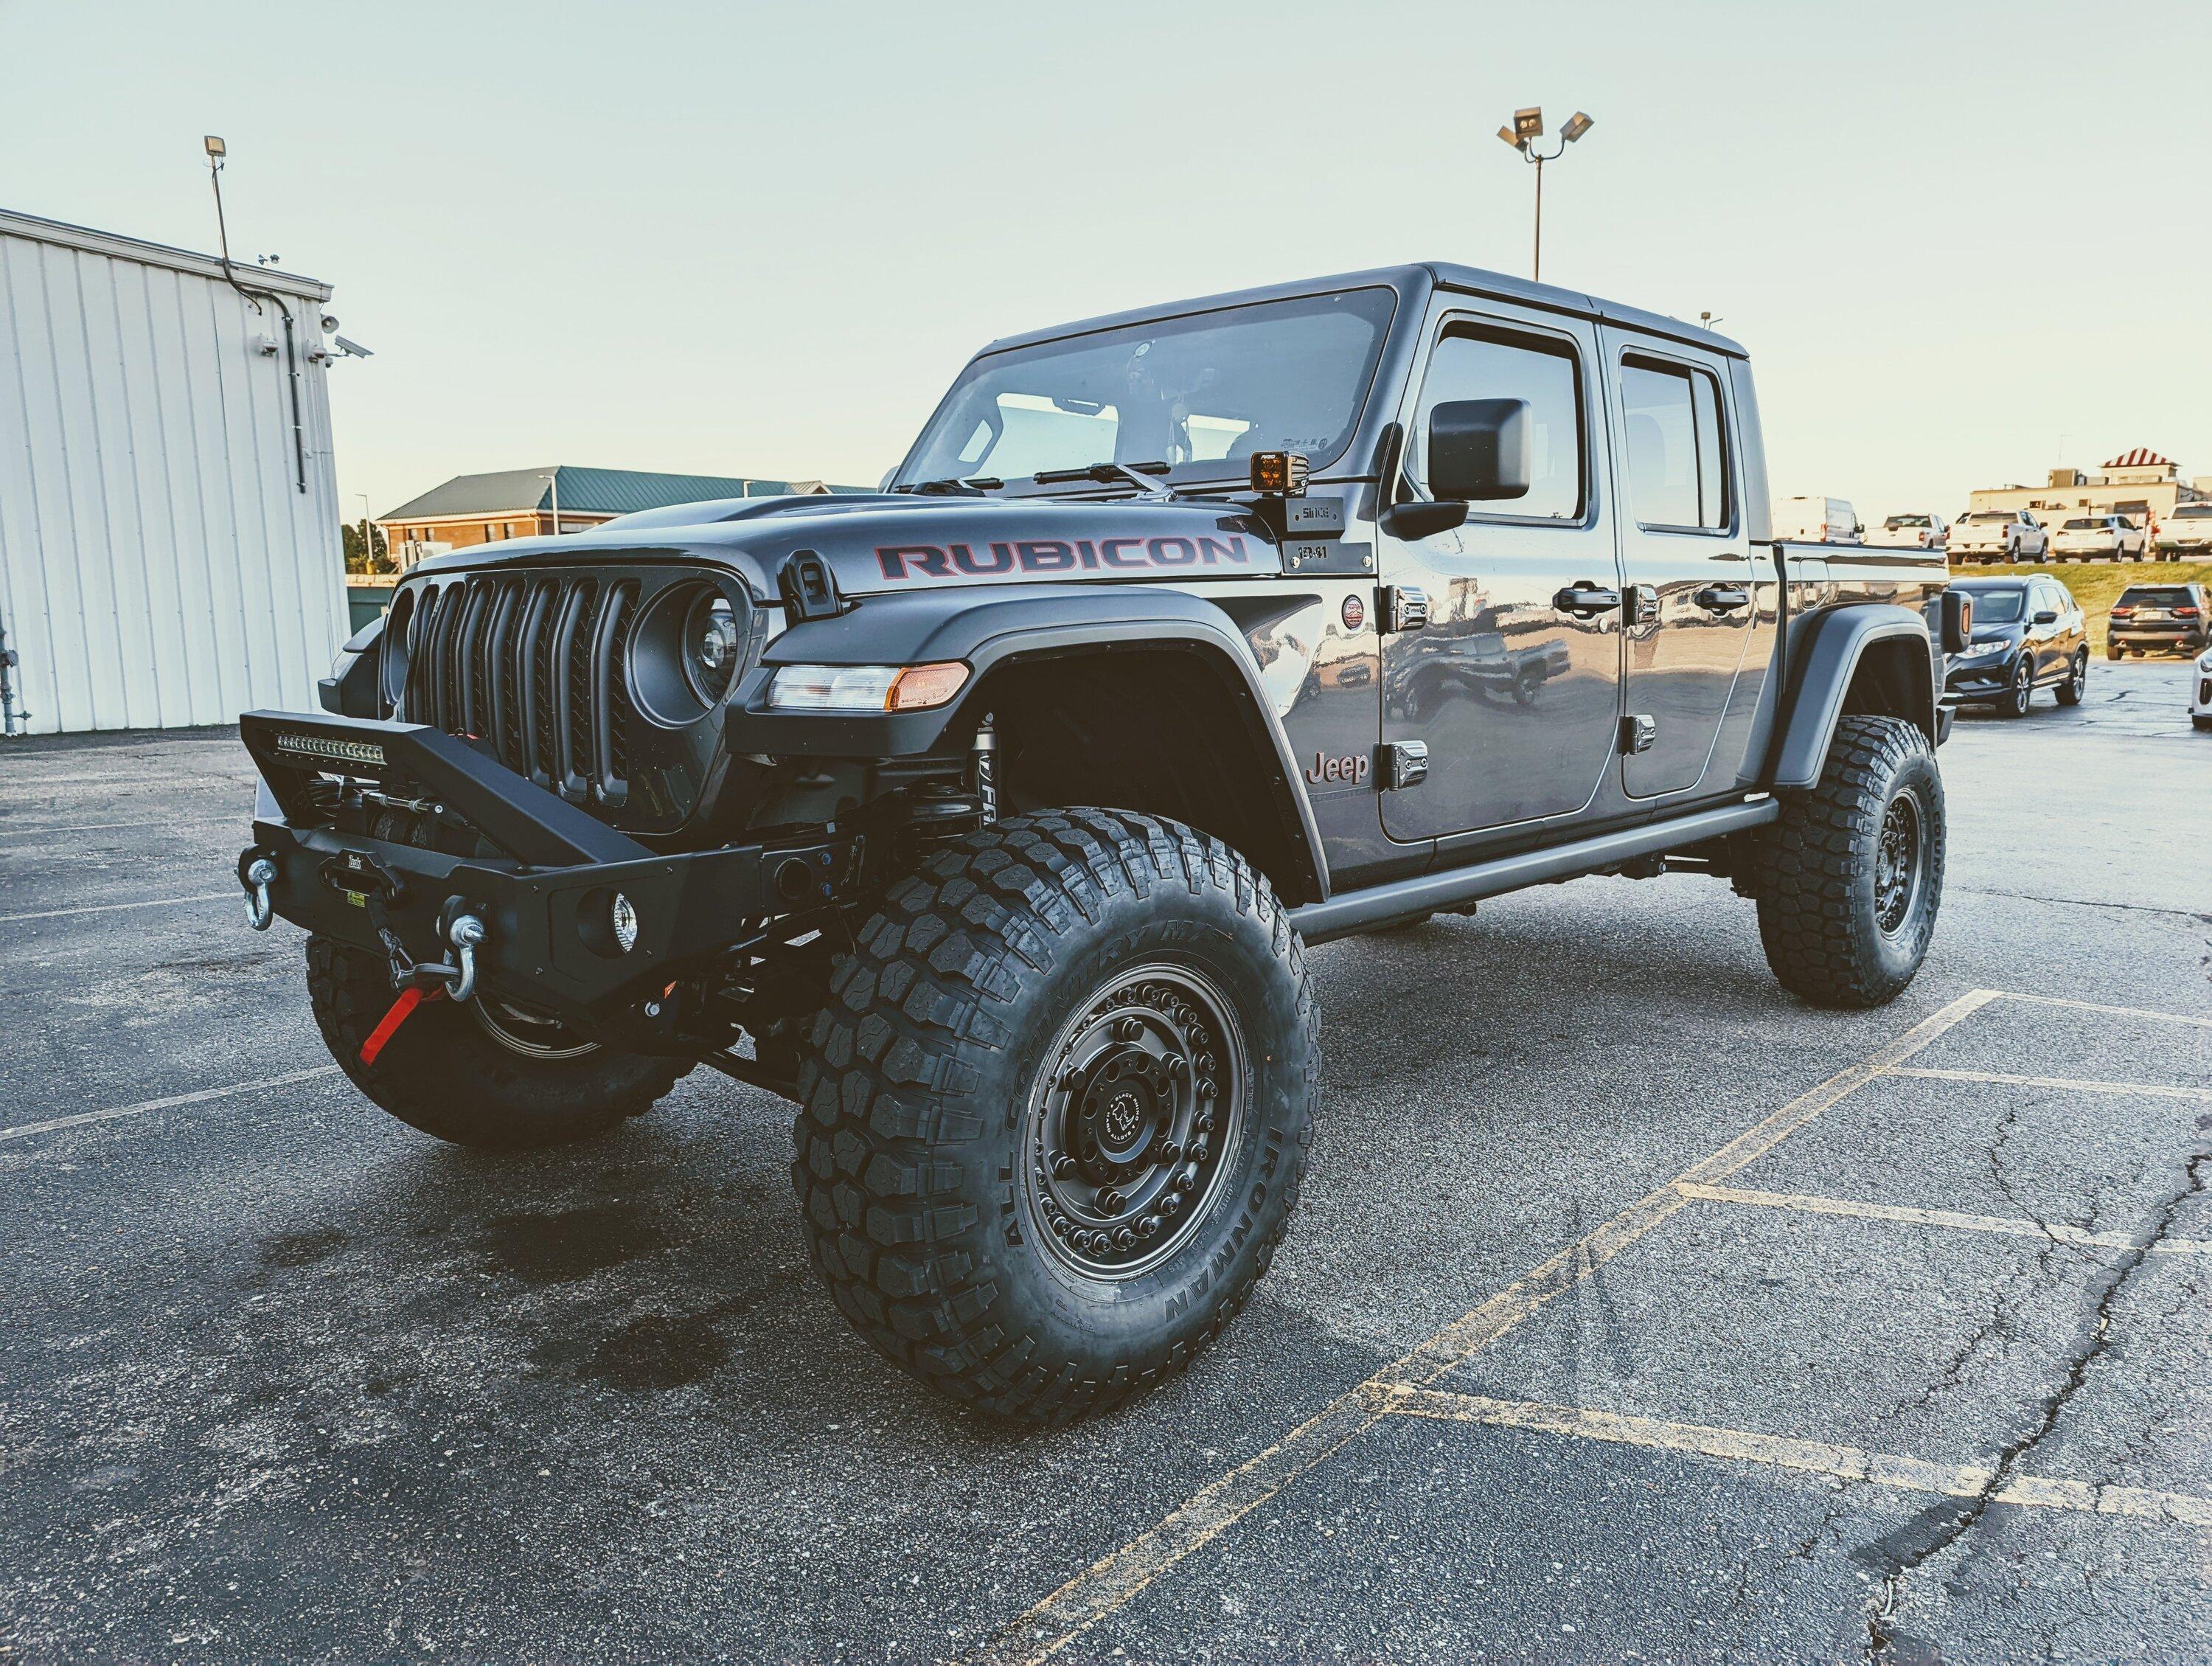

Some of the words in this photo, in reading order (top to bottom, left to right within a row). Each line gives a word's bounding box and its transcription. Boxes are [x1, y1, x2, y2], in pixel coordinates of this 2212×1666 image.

[874, 537, 1250, 580] RUBICON
[1306, 750, 1369, 785] Jeep
[1006, 925, 1150, 1132] COUNTRY
[1115, 1093, 1133, 1101] BLACK
[1110, 1131, 1132, 1140] ALLOYS
[999, 1150, 1025, 1247] ALL
[1165, 1127, 1284, 1322] IRONMAN
